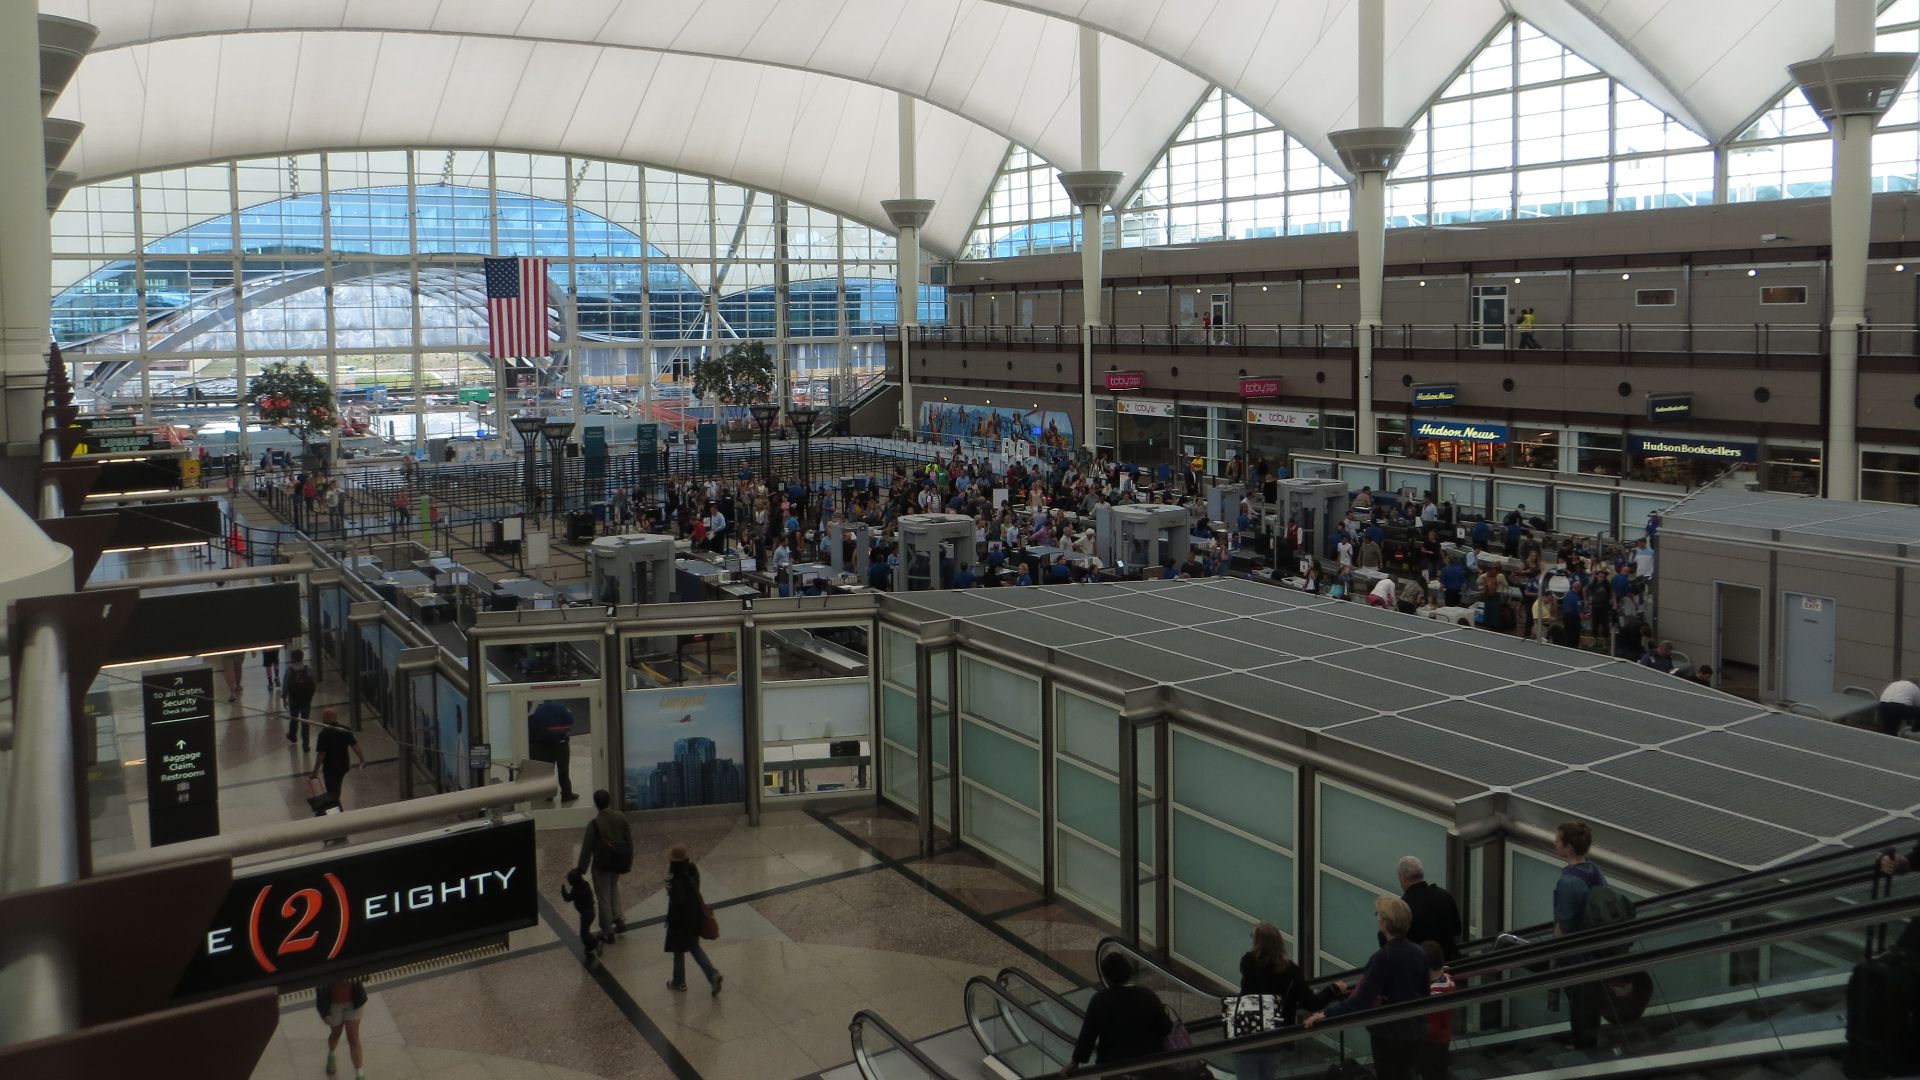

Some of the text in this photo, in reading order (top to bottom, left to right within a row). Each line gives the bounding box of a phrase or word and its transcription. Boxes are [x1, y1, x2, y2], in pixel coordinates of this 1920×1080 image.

[1418, 424, 1500, 440] Hudson News
[154, 687, 205, 699] to all Gates,
[163, 697, 197, 708] Security
[163, 752, 201, 763] Baggage
[169, 762, 195, 771] Claim,
[161, 769, 205, 782] Restrooms
[365, 866, 517, 920] EIGHTY
